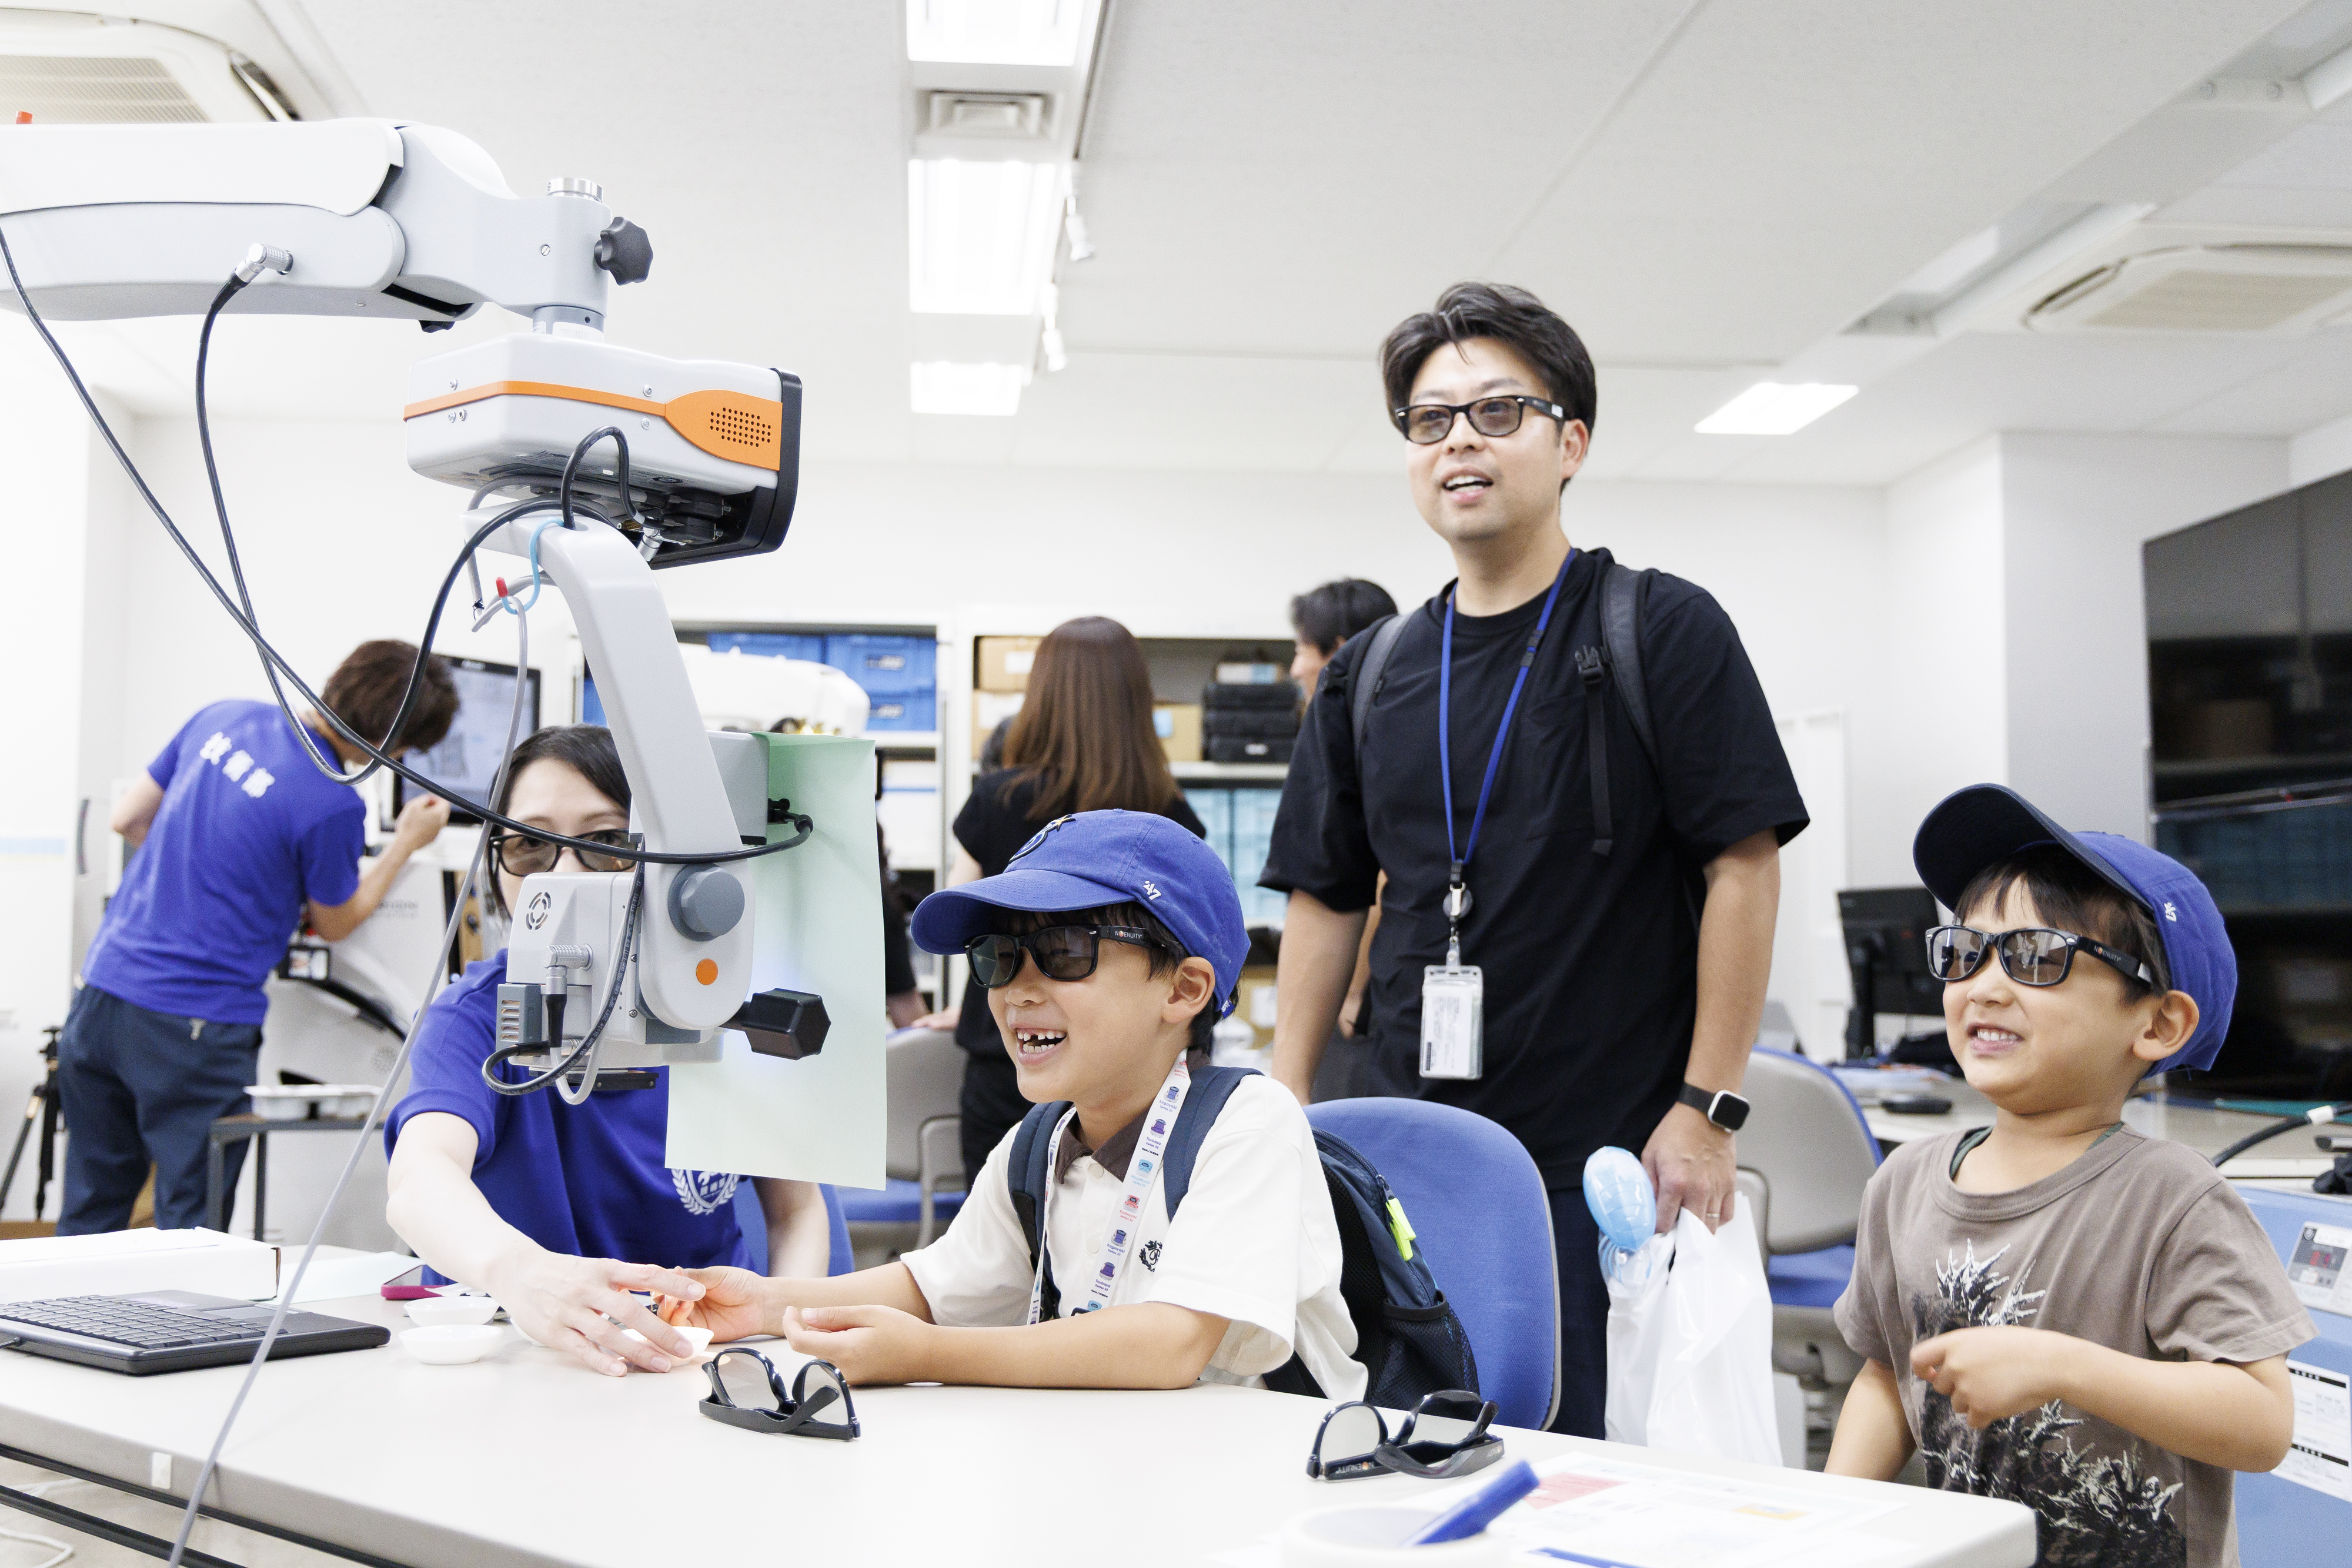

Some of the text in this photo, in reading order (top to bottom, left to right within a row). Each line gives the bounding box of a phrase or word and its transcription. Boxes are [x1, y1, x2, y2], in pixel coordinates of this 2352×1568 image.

[602, 1009, 612, 1021] 2587
[1159, 1100, 1177, 1109] Kagayaki
[1146, 1136, 1161, 1145] Tsubasa
[1131, 1174, 1150, 1185] Hayabusa
[1120, 1209, 1137, 1219] Komachi
[1107, 1243, 1125, 1253] Kagayaki
[1095, 1279, 1111, 1288] Tsubasa
